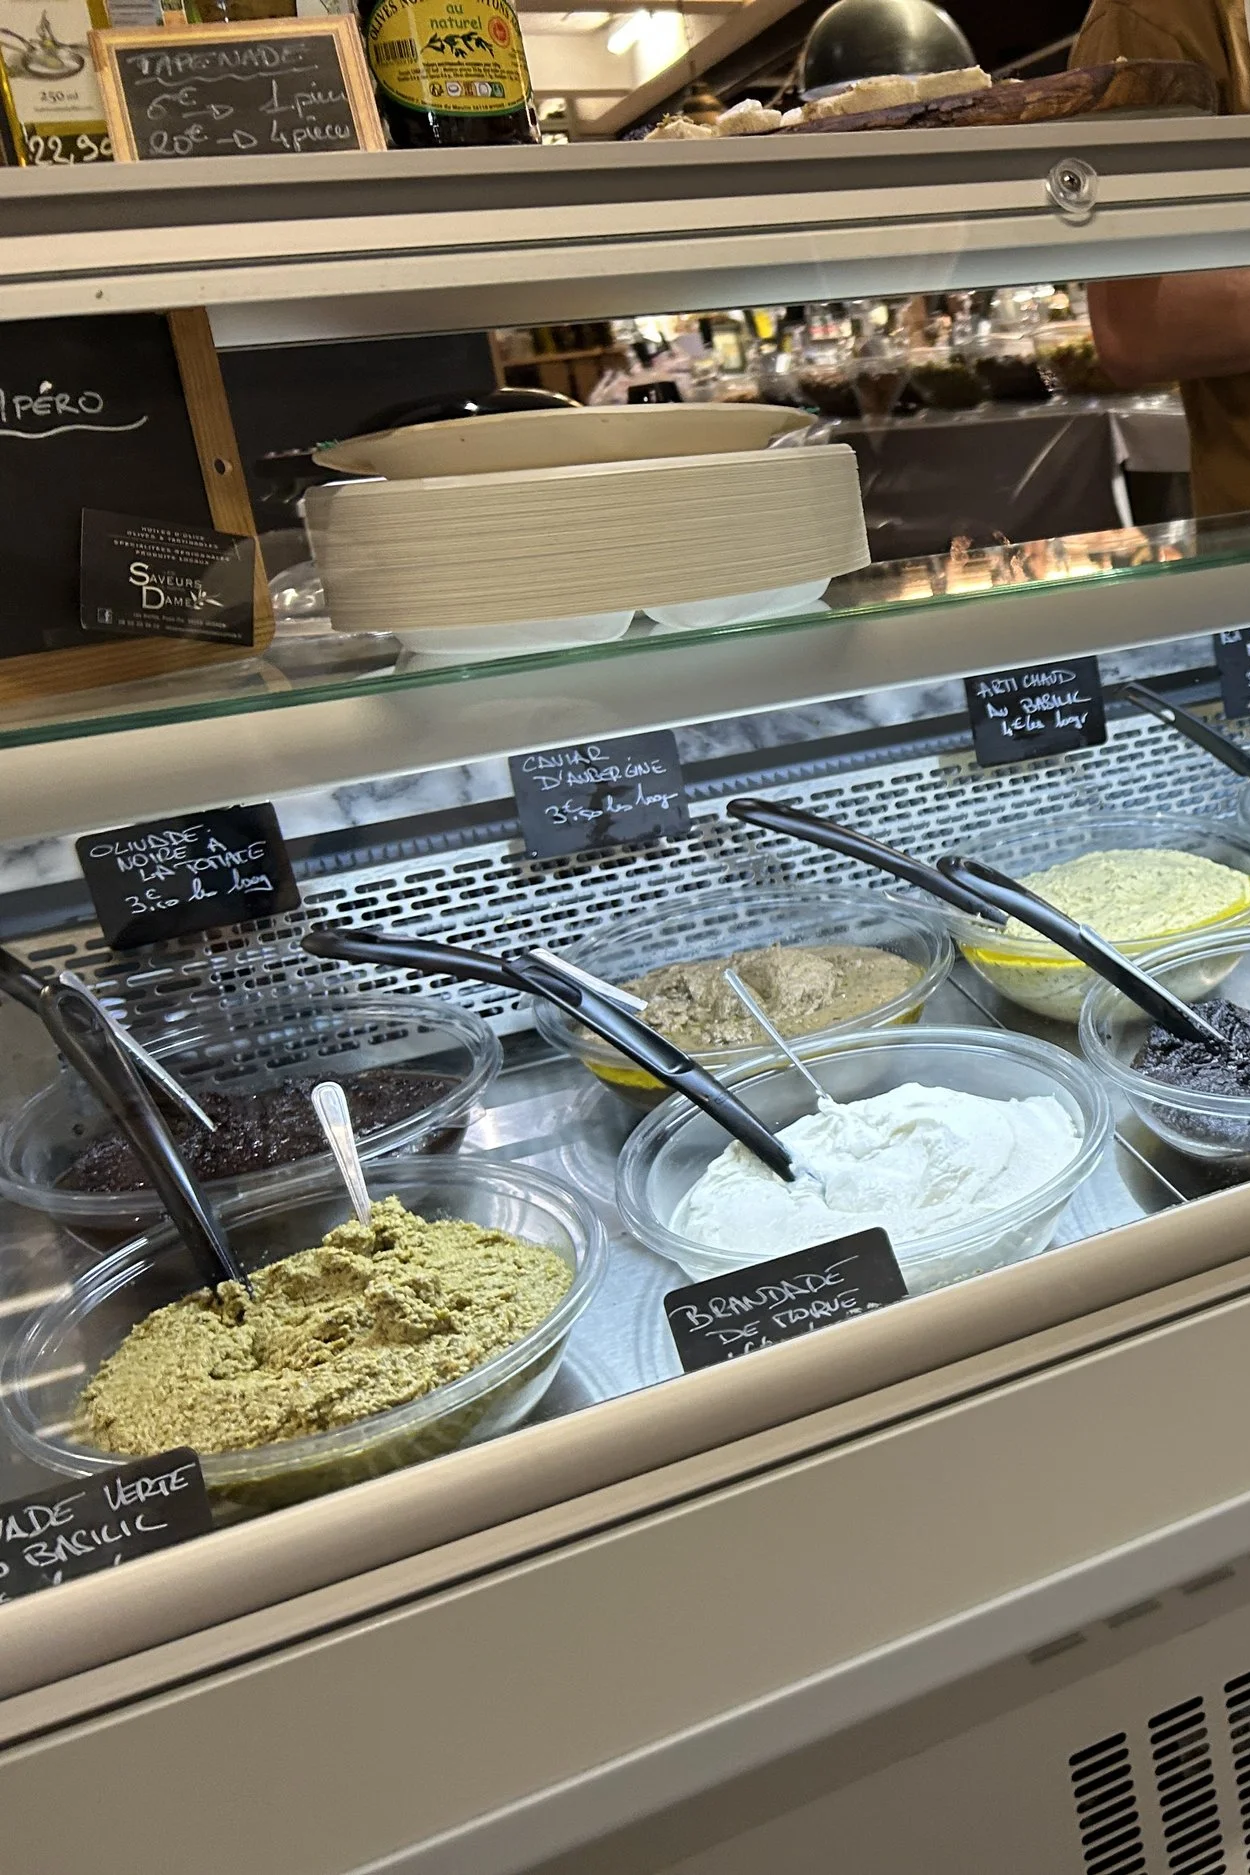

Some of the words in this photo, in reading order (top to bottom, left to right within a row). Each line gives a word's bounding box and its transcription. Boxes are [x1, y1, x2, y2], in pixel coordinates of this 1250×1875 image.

[369, 0, 398, 41] OLIVES
[430, 16, 482, 30] naturel
[446, 4, 464, 14] au
[125, 43, 310, 76] TAPENADE
[128, 561, 203, 588] SAVEURS
[522, 745, 610, 773] CAVIAR
[533, 756, 668, 791] D'AUBERGINE
[90, 824, 204, 858] OLIVADE
[116, 846, 188, 873] NOIRE
[140, 864, 175, 882] LA
[173, 841, 267, 875] TOMATE
[668, 1254, 860, 1333] BRANDADE
[704, 1320, 761, 1345] DE
[771, 1288, 860, 1329] MORUE
[0, 1491, 86, 1542] ADE
[103, 1462, 196, 1511] VERTE
[23, 1513, 169, 1567] BASILIC
